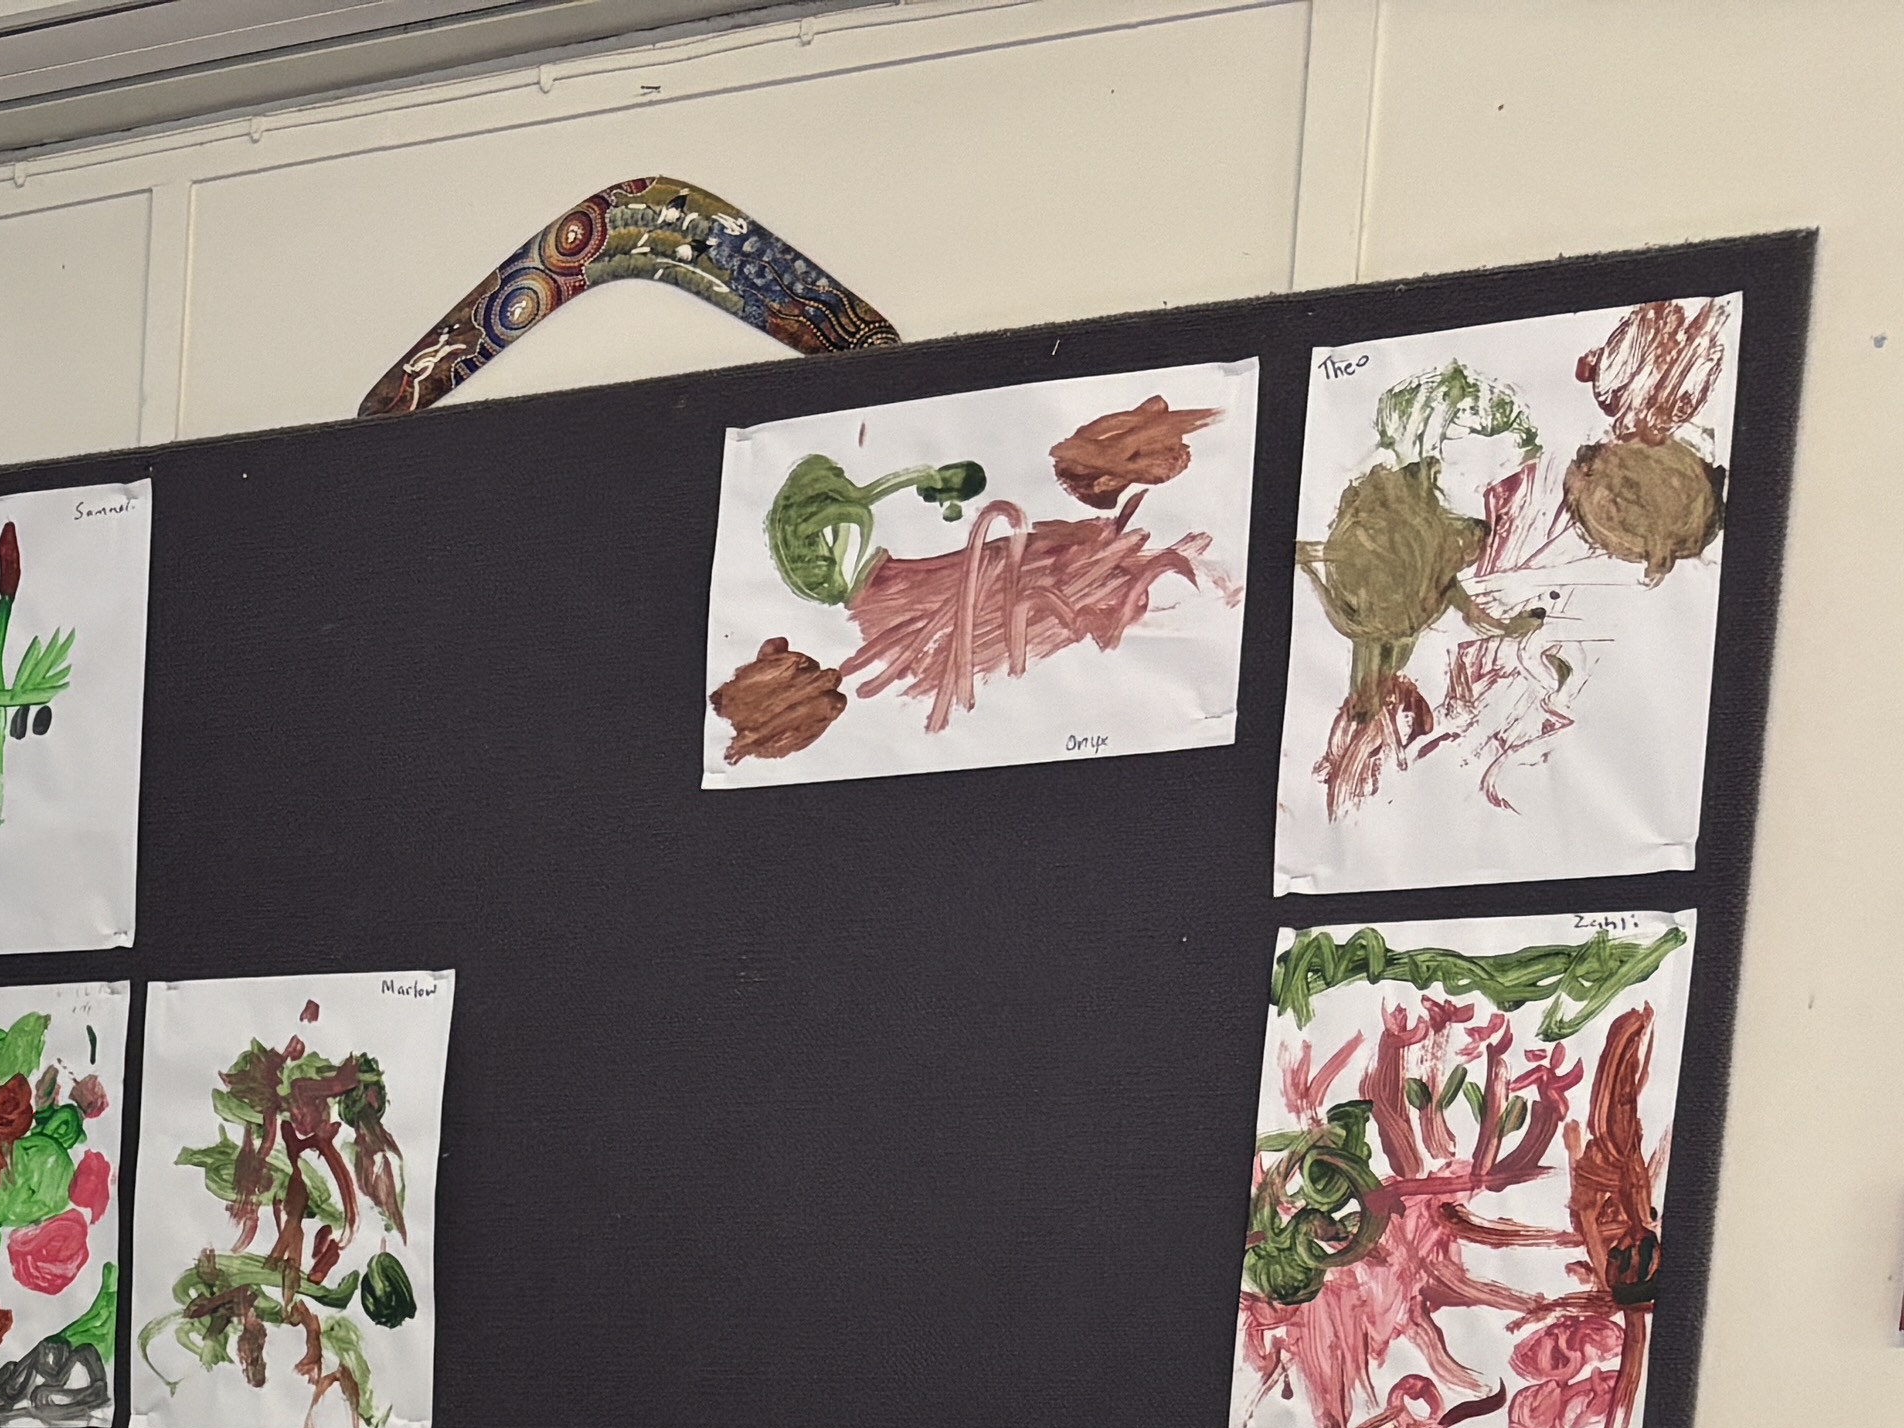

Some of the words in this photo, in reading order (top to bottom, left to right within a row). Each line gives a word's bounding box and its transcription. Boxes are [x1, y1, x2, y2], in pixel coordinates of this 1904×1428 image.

[1317, 354, 1370, 380] Theo
[1065, 734, 1109, 754] Onyx
[381, 979, 438, 999] Marlow
